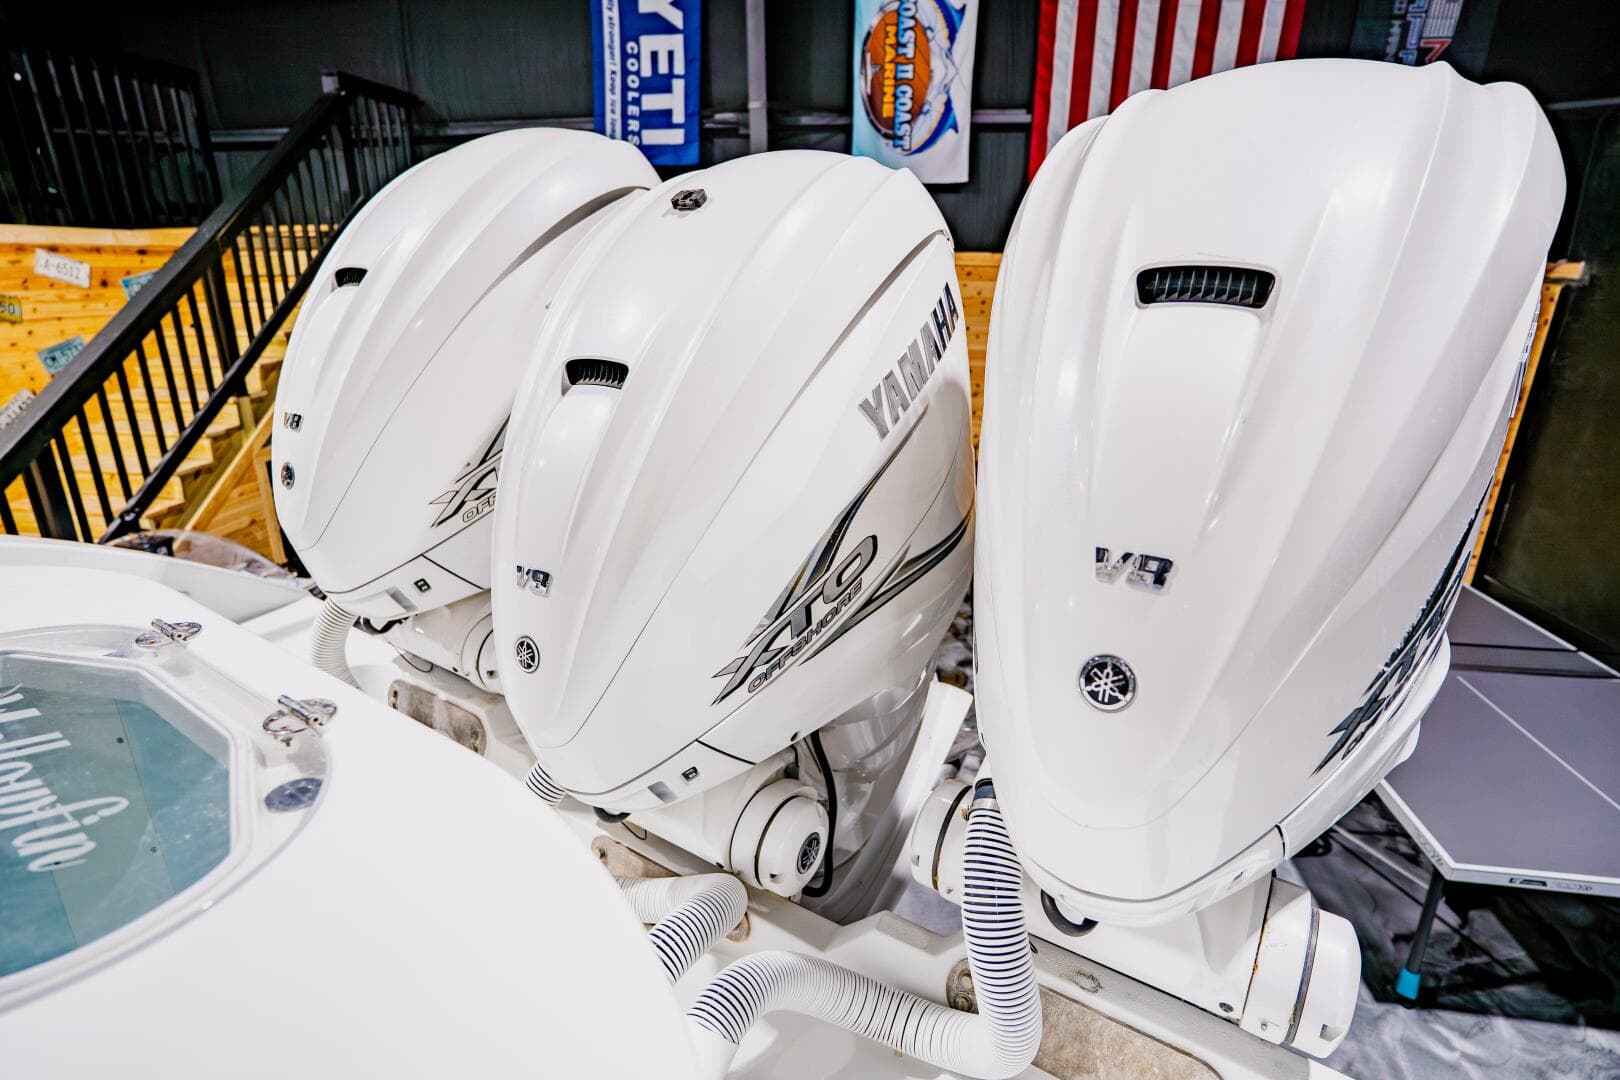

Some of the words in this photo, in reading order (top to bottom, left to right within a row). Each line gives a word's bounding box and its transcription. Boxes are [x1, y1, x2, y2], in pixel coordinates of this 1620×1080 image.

[896, 0, 917, 58] OAST
[608, 69, 617, 96] Keep
[626, 41, 640, 147] COOLERS
[634, 0, 687, 146] YETI
[882, 25, 897, 118] MARINE
[609, 98, 618, 115] ice
[893, 84, 914, 150] COAST
[858, 281, 960, 440] YAMAHA
[283, 411, 304, 432] V8
[515, 565, 554, 598] V8
[1094, 546, 1178, 596] V8
[710, 534, 878, 706] XTO
[747, 577, 863, 694] OFFSHORE
